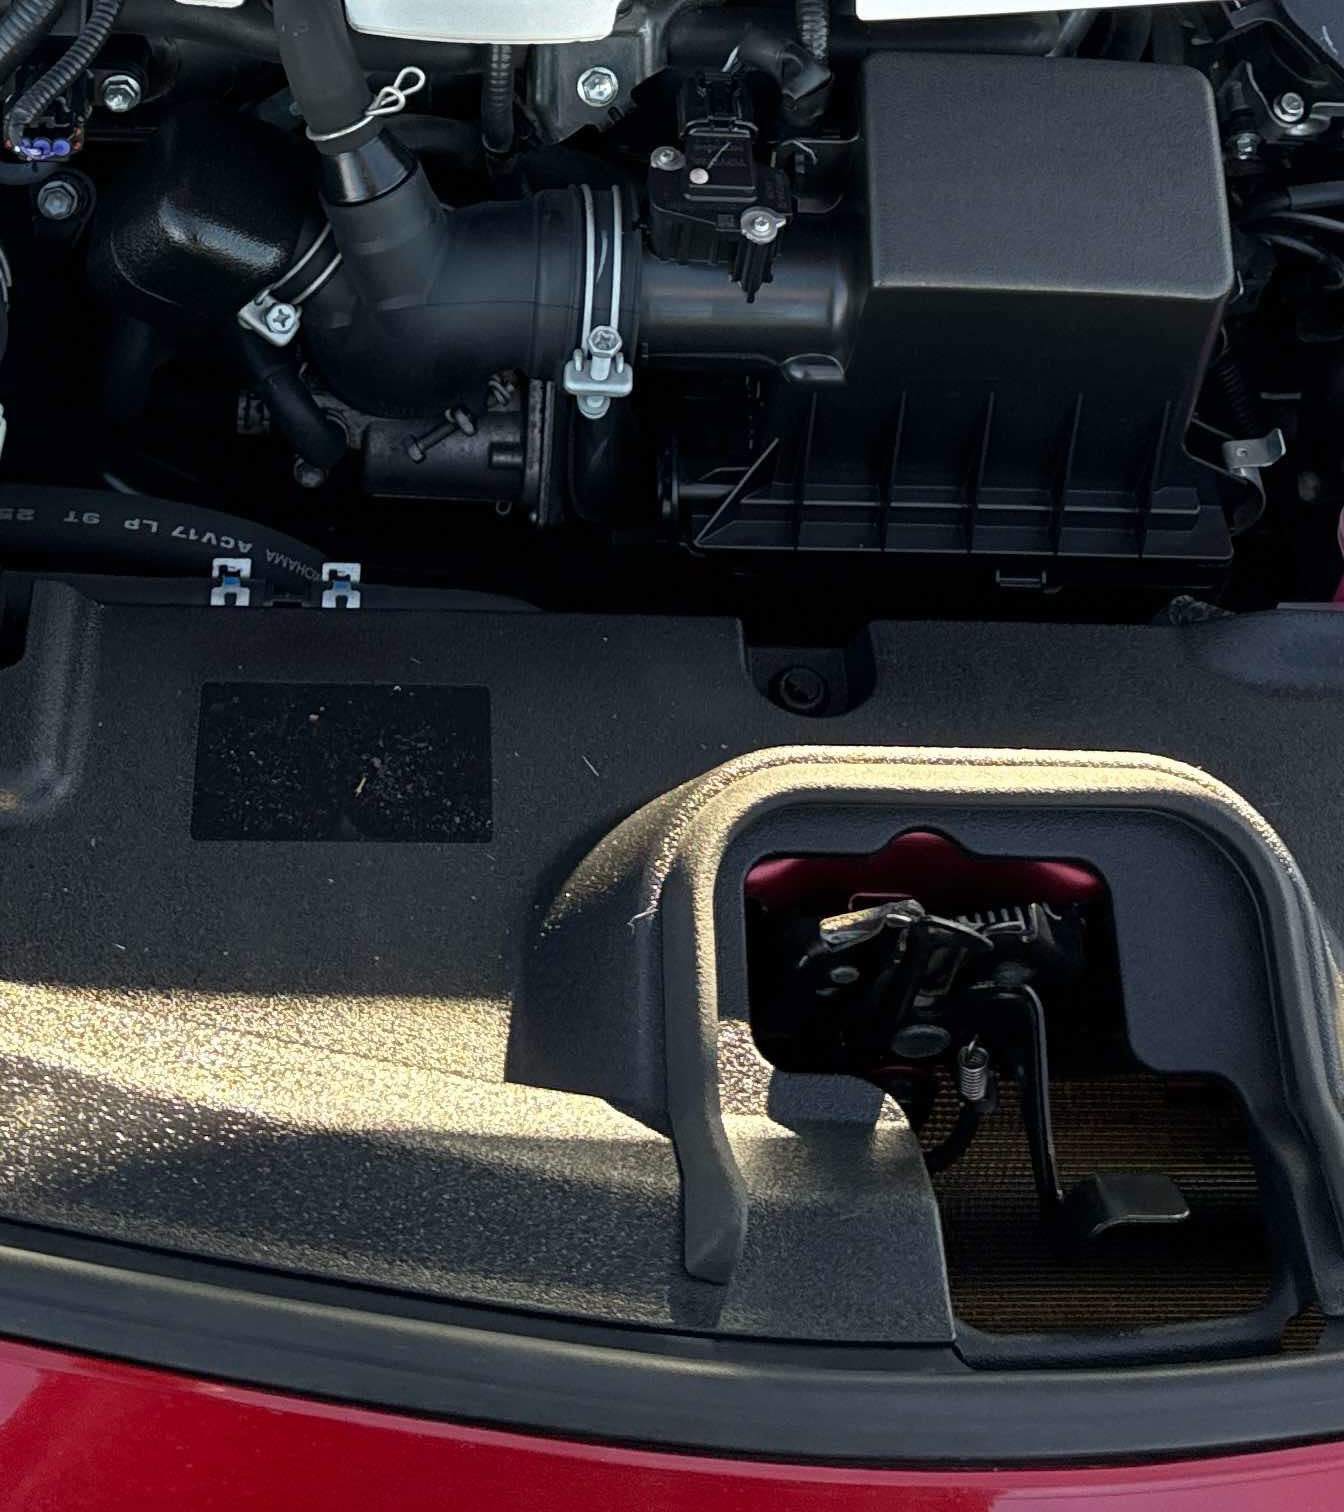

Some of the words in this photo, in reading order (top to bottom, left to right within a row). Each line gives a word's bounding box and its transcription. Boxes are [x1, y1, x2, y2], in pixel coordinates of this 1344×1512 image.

[123, 516, 160, 534] LP
[170, 529, 254, 554] ACV17
[265, 547, 321, 583] KOHAMA
